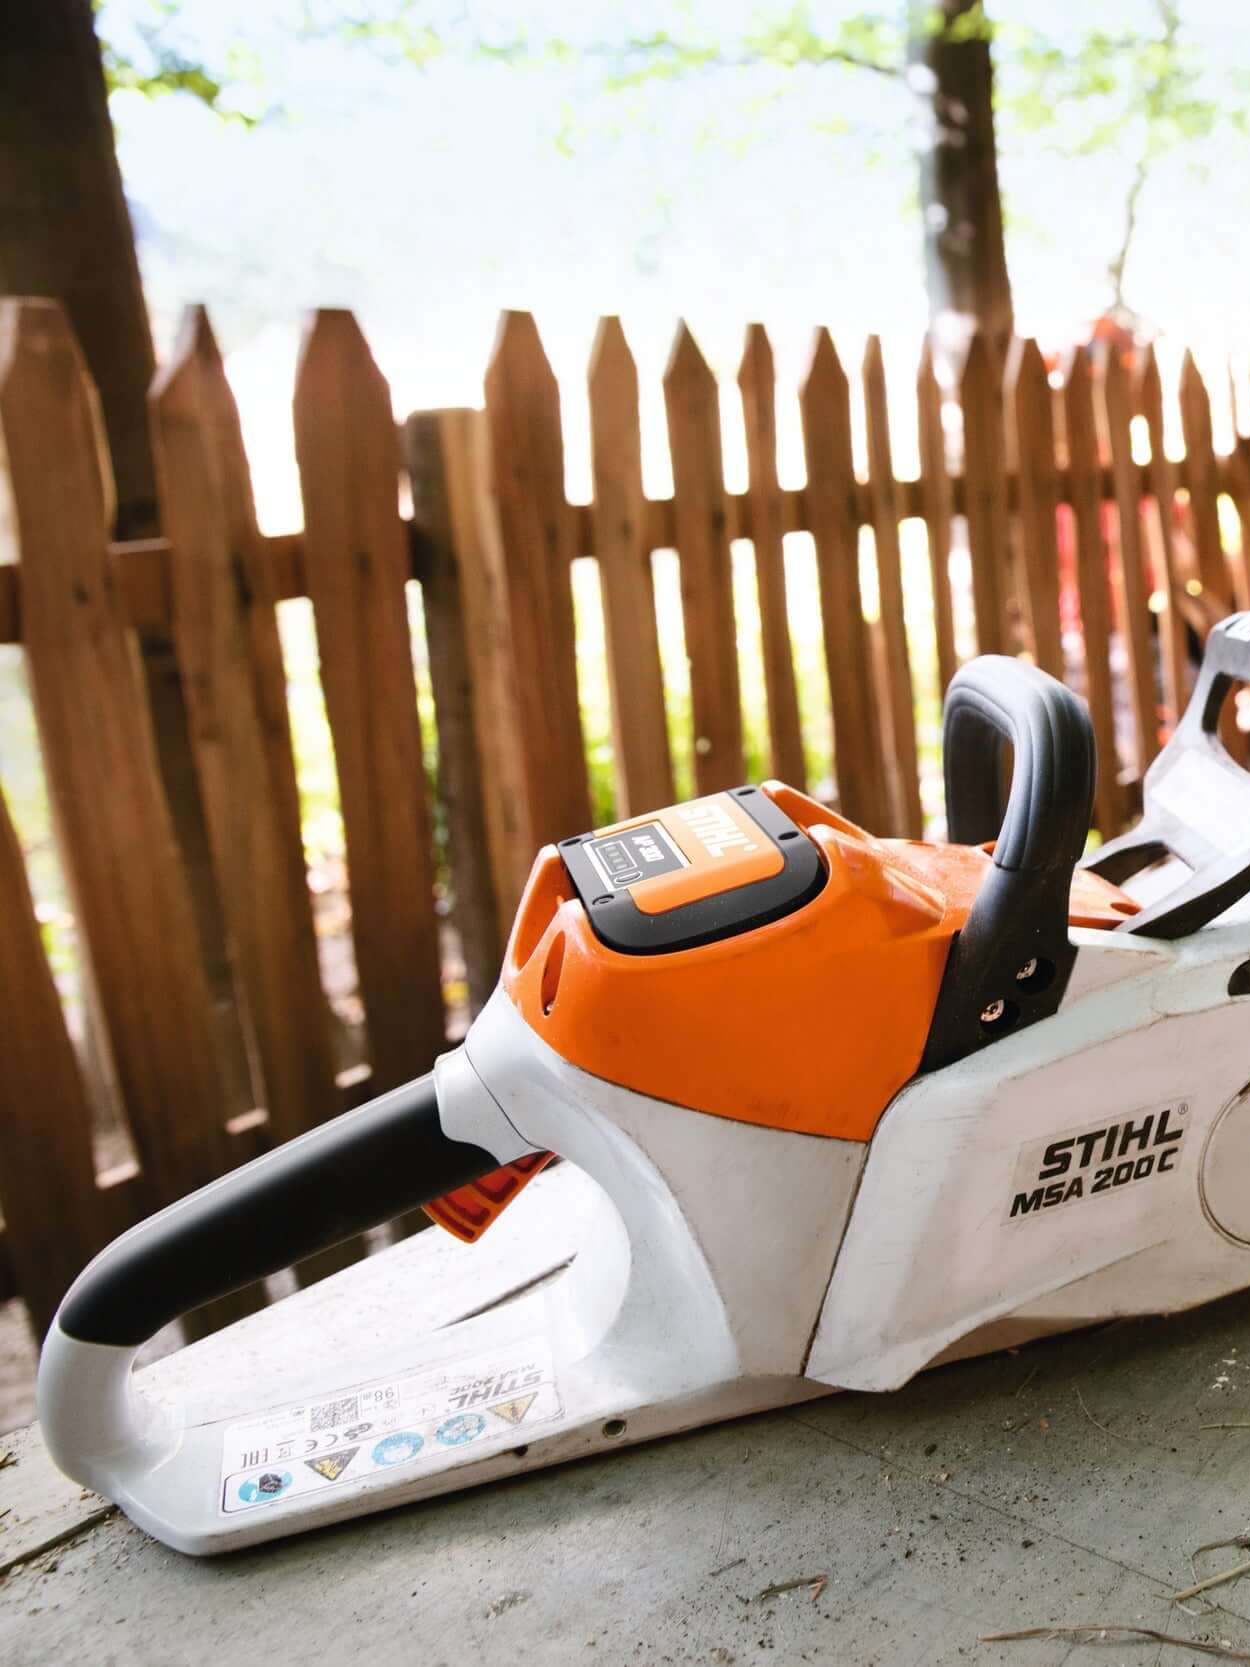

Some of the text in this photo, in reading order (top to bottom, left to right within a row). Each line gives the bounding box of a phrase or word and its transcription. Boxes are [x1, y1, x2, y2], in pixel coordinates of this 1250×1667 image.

[677, 804, 753, 857] STIHL
[1039, 1110, 1184, 1181] STIHL
[1010, 1176, 1083, 1218] MSA
[448, 1369, 544, 1409] STIHL
